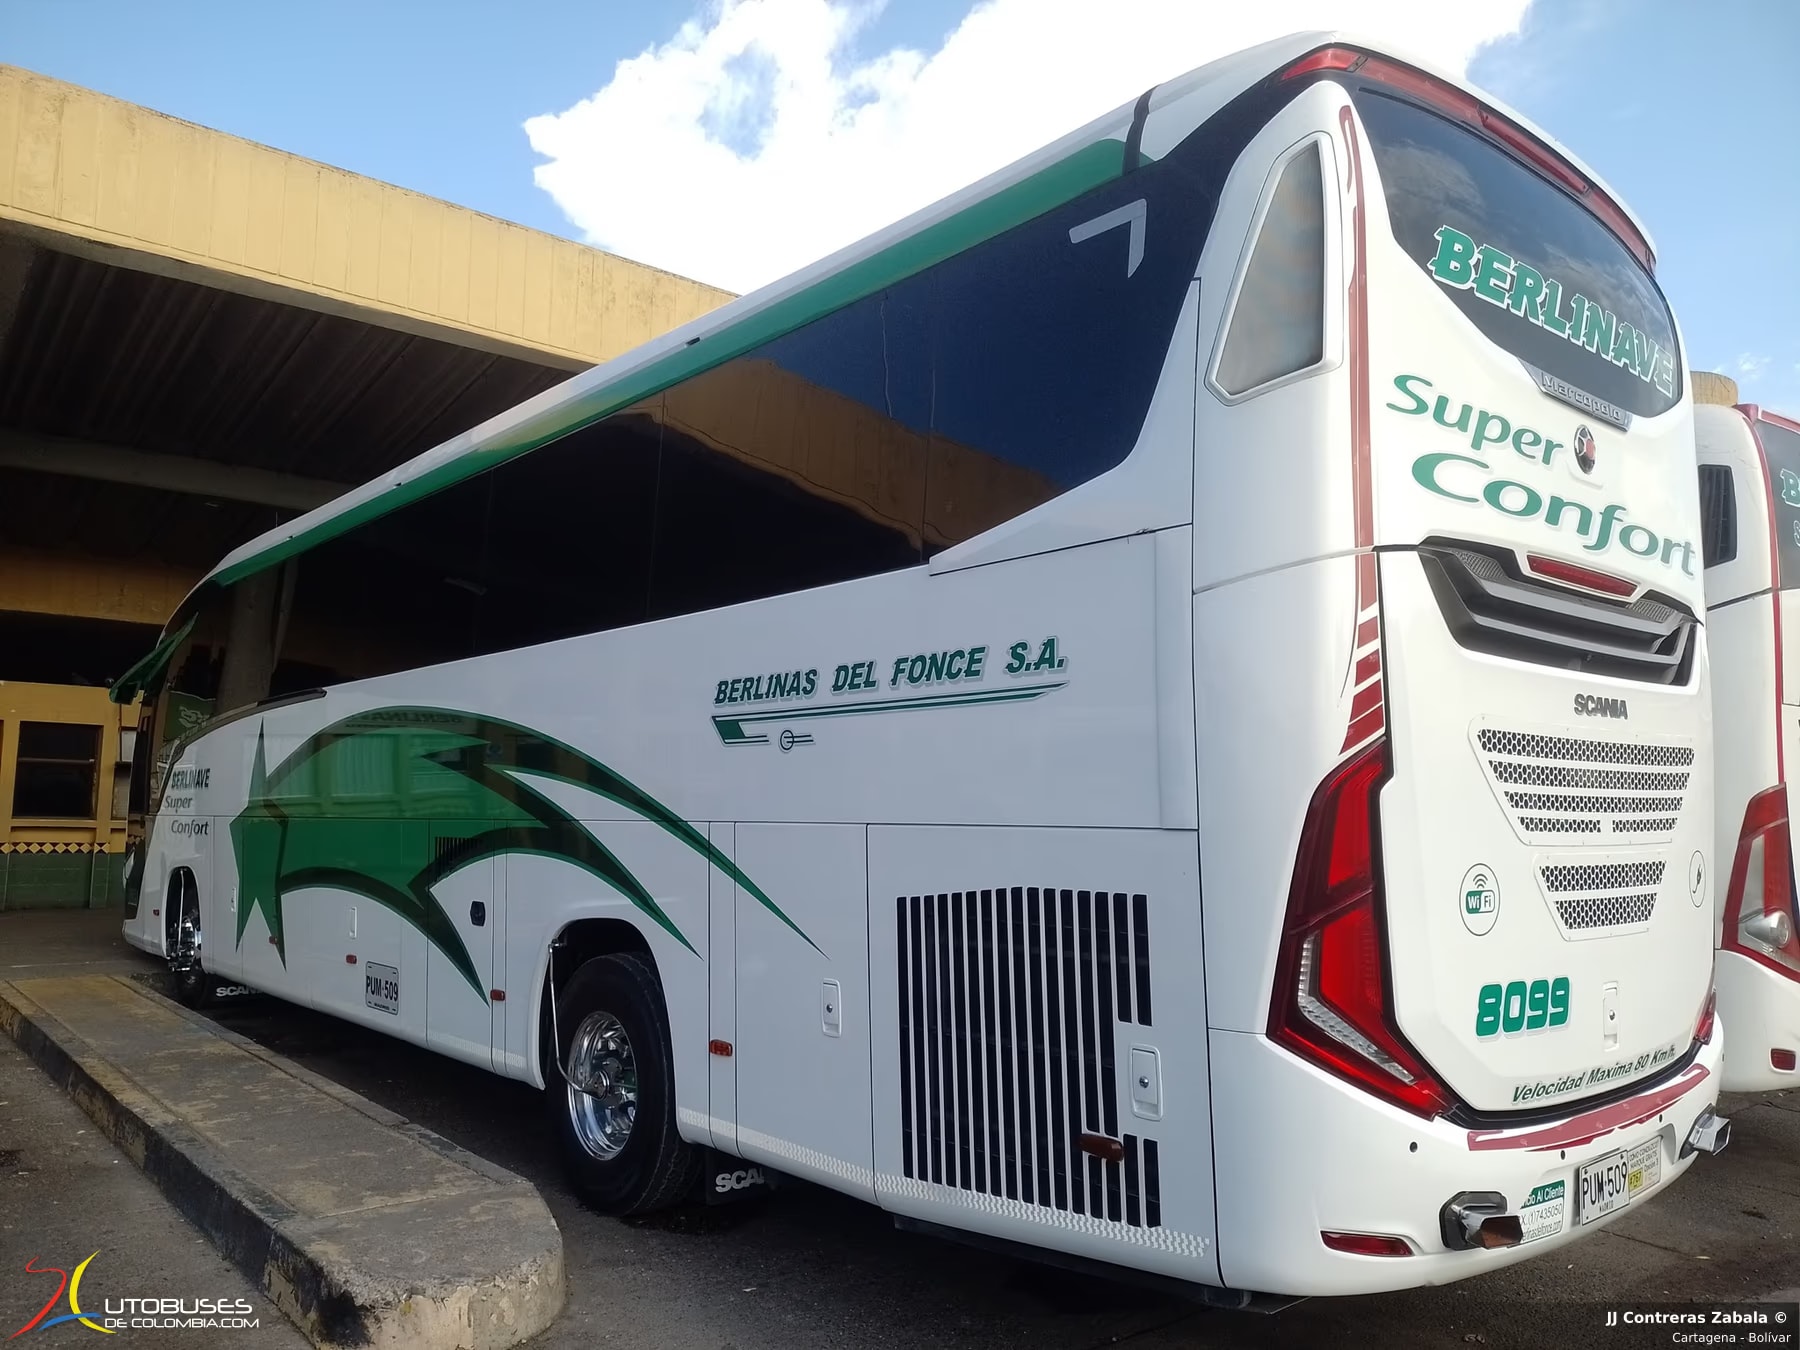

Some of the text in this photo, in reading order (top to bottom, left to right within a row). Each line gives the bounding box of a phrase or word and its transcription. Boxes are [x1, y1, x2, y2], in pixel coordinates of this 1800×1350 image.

[1428, 225, 1673, 399] BERLINAVE
[1386, 374, 1564, 466] Super
[1541, 371, 1621, 421] Marcopolo
[1411, 452, 1696, 577] Confort
[714, 636, 1066, 704] BERLINAS DEL FONCE S.A.
[1574, 693, 1628, 720] SCANIA
[171, 768, 210, 789] BERLINAVE
[164, 795, 193, 814] Super
[171, 819, 209, 838] Confort
[1475, 976, 1571, 1038] 8099
[1512, 1072, 1585, 1102] Velocidad
[1586, 1061, 1633, 1085] Maxima
[1634, 1053, 1650, 1070] 80
[1544, 1185, 1564, 1200] Cliente
